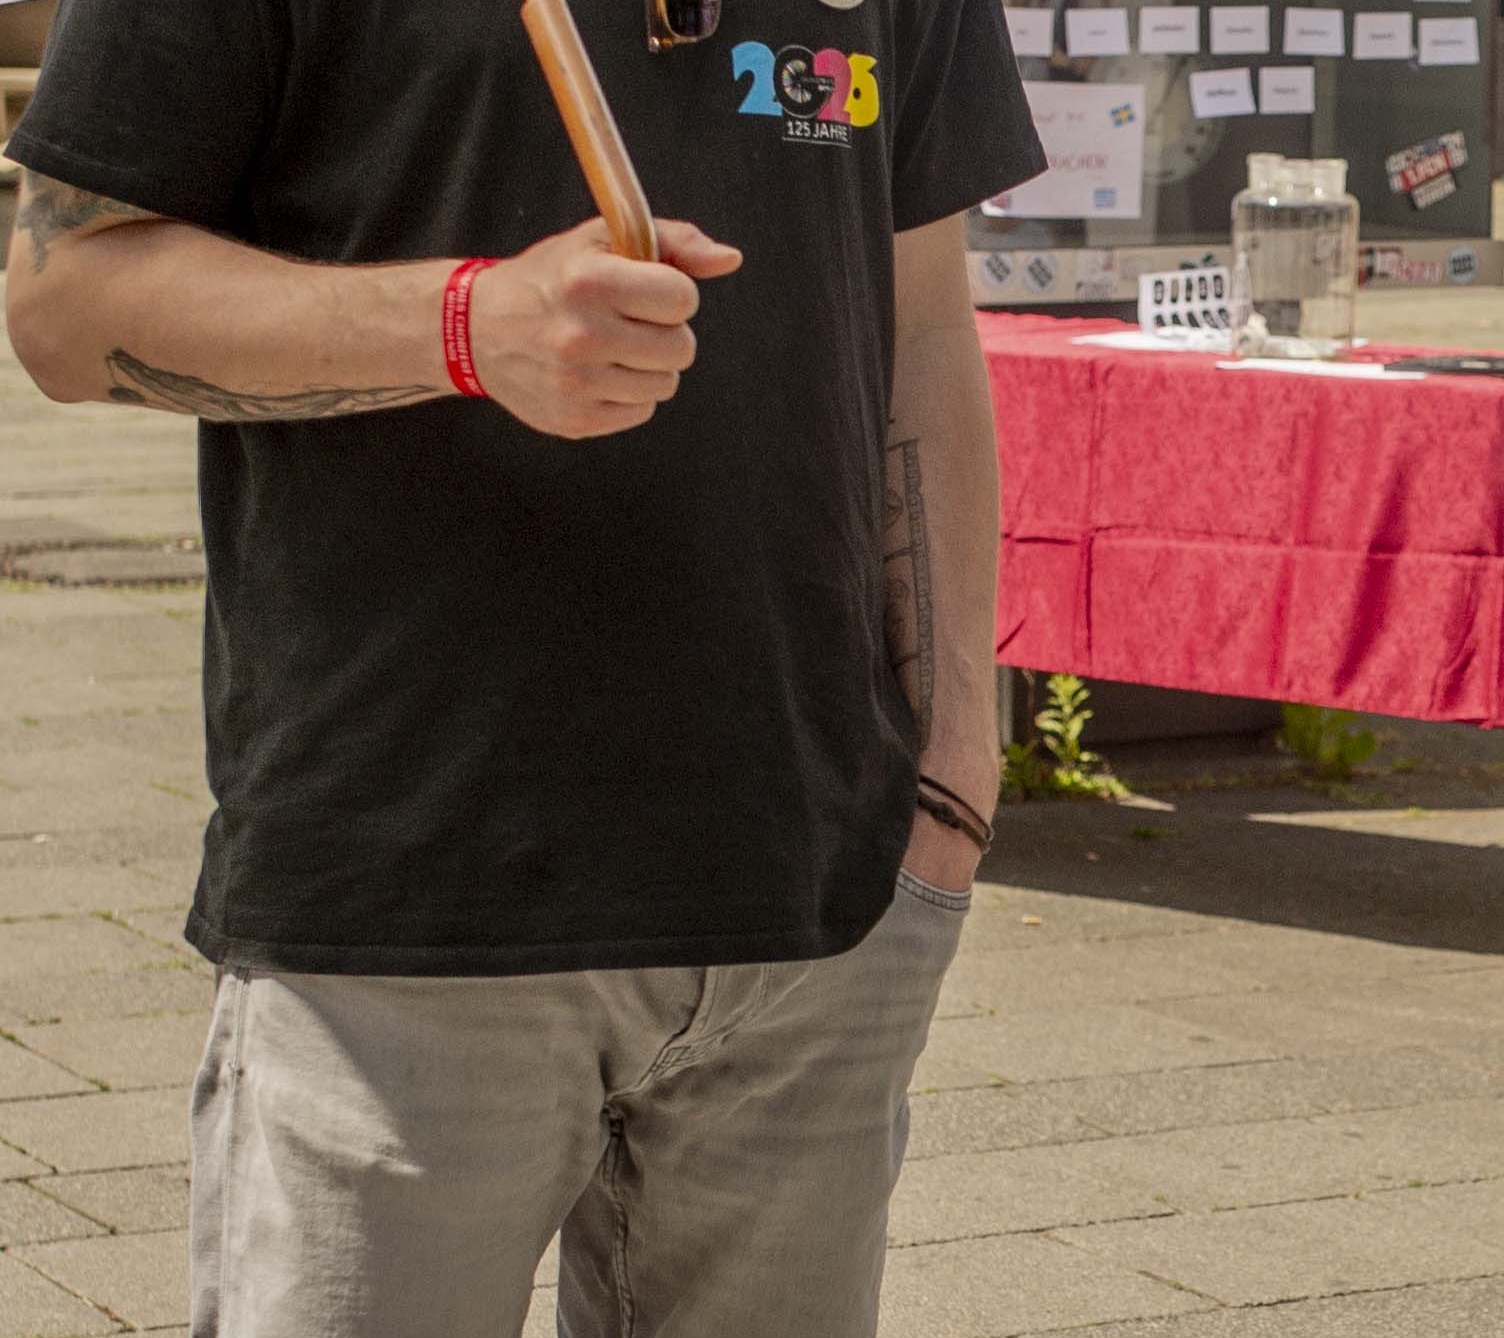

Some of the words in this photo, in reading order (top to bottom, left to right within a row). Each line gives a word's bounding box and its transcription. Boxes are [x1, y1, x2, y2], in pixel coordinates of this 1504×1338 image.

[731, 41, 880, 128] 2025
[787, 121, 811, 137] 125
[813, 121, 848, 142] JAHRE
